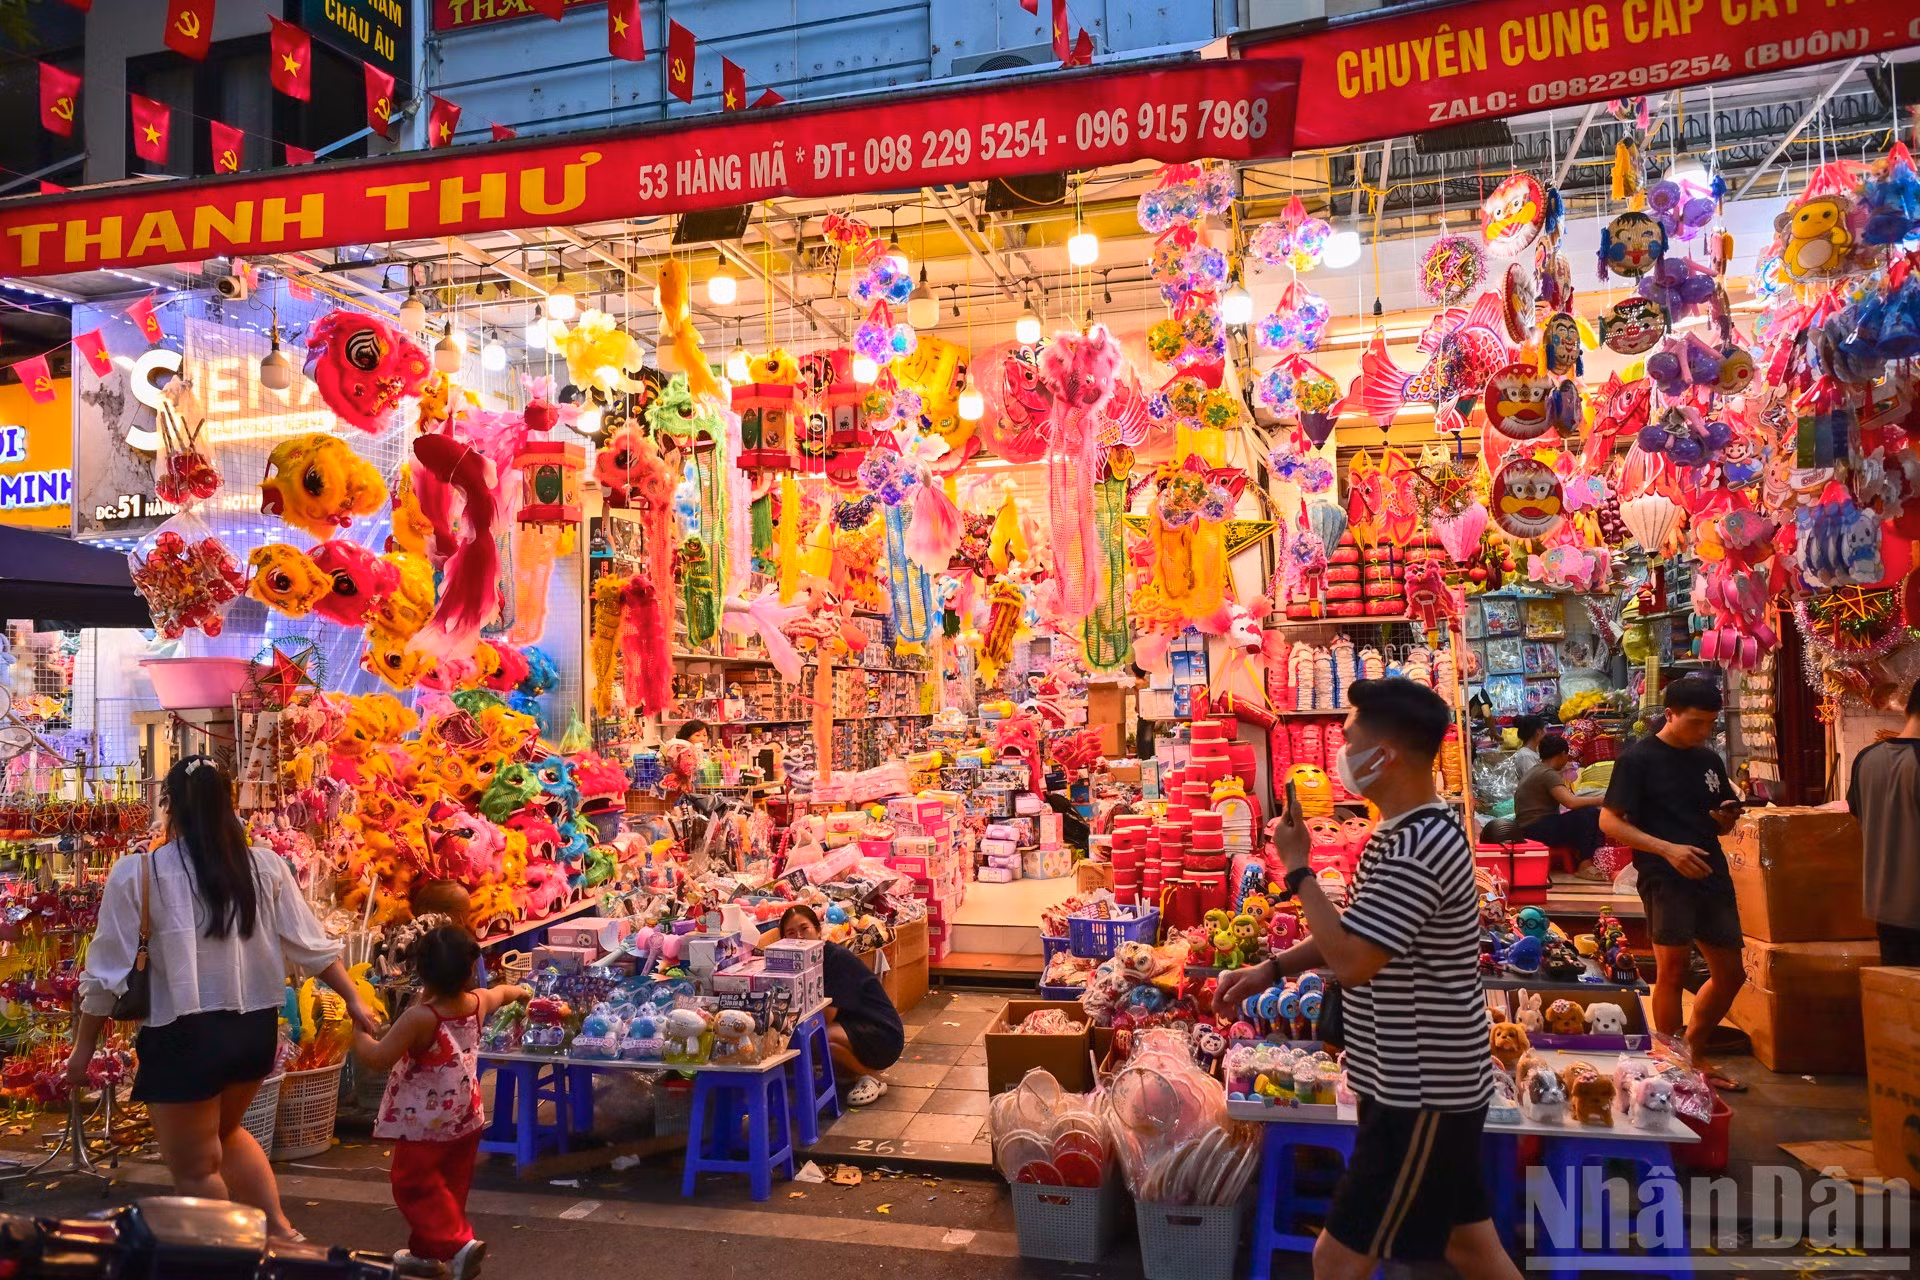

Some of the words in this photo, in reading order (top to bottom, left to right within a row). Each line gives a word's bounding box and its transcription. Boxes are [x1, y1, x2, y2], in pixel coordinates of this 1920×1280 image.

[325, 0, 369, 44] CHÂU
[374, 24, 395, 62] ÂU
[1336, 25, 1488, 99] CHUYÊN
[1500, 3, 1609, 67] CUNG
[1429, 89, 1517, 122] ZALO:
[1528, 54, 1731, 105] 0982295254
[1745, 28, 1870, 69] (BUÔN)
[639, 163, 668, 200] 53
[676, 149, 742, 197] HÀNG
[750, 140, 787, 189] MÃ
[813, 142, 855, 180] ĐT:
[864, 133, 913, 176] 098
[921, 127, 972, 170] 229
[980, 117, 1048, 160] 5254
[1076, 107, 1129, 151] 096
[1137, 102, 1188, 144] 915
[1197, 97, 1269, 140] 7988
[7, 192, 325, 267] THANH
[366, 152, 602, 230] THƯ
